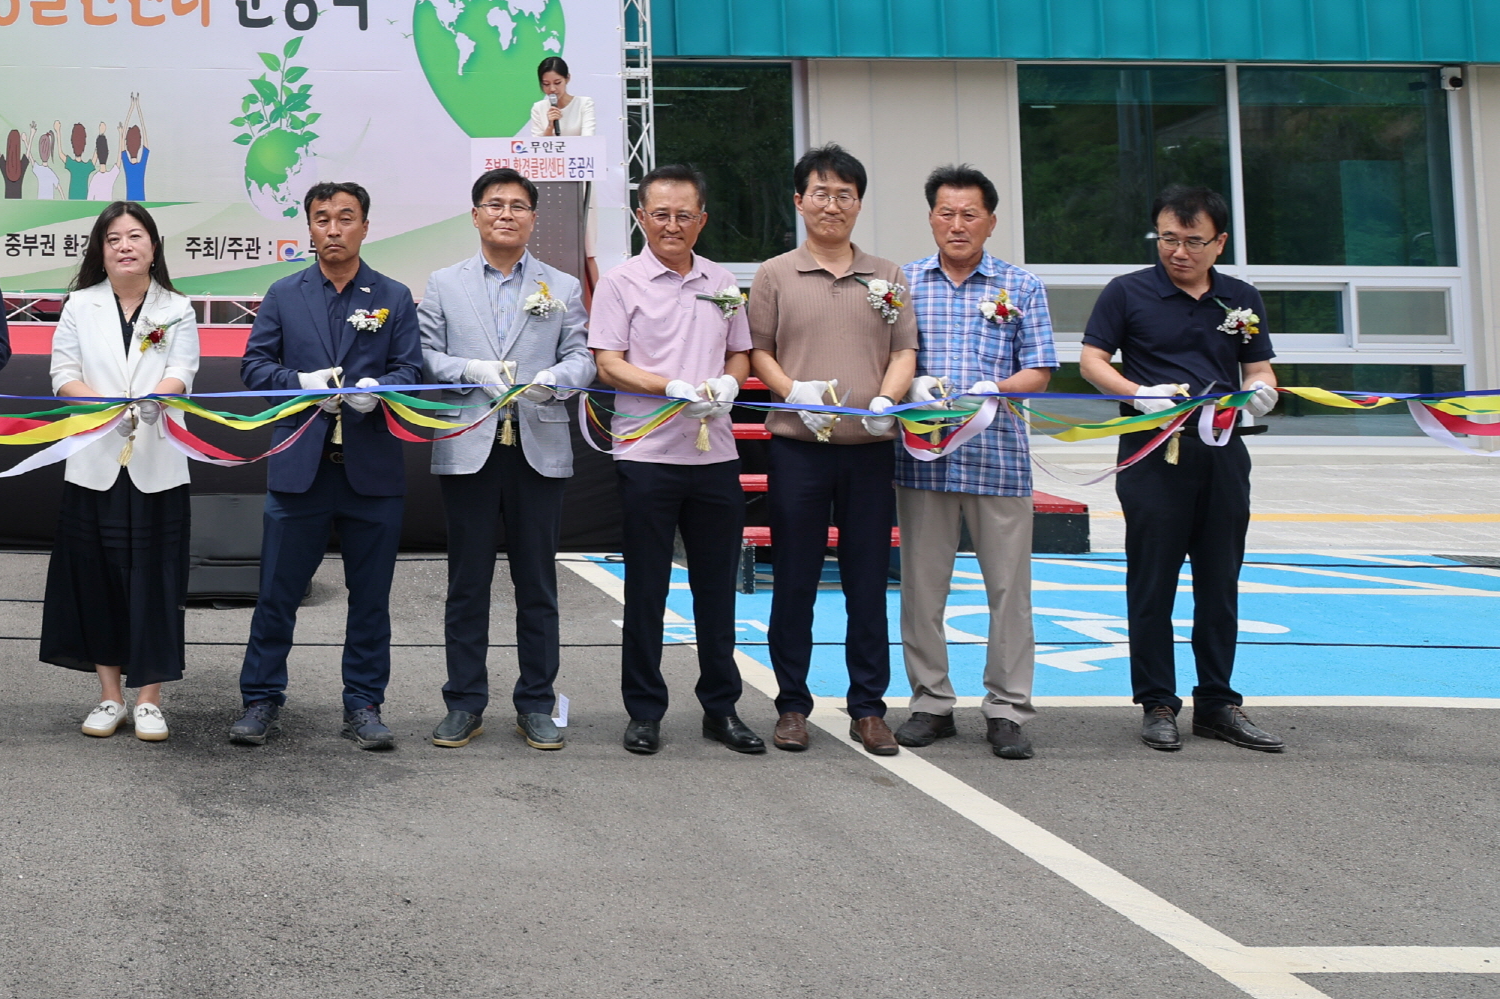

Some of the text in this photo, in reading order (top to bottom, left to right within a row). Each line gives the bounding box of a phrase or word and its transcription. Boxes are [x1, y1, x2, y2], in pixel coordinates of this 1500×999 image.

[530, 141, 566, 153] 무안군
[513, 157, 565, 178] 환경클린센터
[568, 157, 594, 178] 준공식
[5, 233, 55, 257] 중부권
[185, 235, 261, 260] 주최/주관
